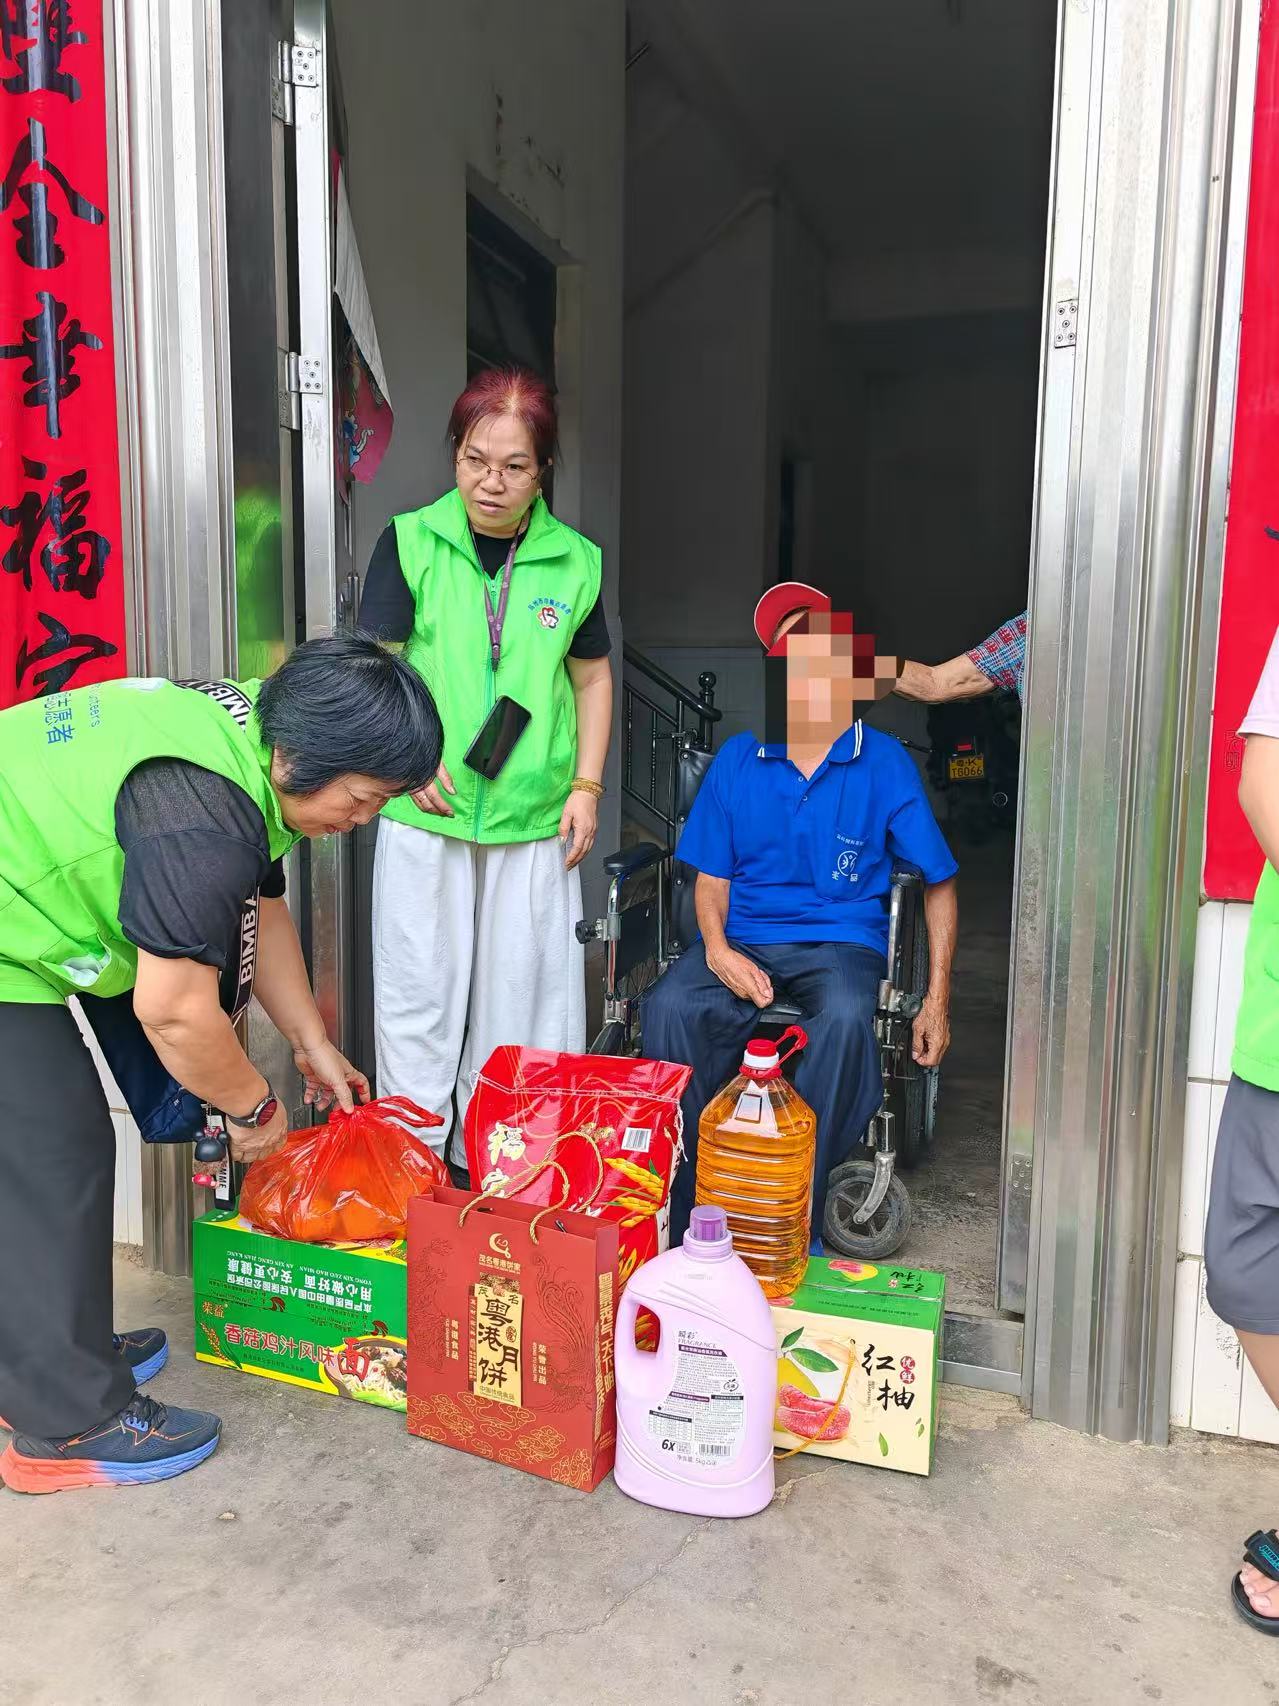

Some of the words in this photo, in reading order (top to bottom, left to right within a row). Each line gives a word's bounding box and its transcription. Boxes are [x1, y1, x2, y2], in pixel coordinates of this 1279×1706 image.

[227, 1258, 293, 1284] 安心更健康
[304, 1274, 372, 1301] 用心做好面
[478, 1298, 519, 1389] 粤港月饼
[861, 1343, 915, 1411] 红柚
